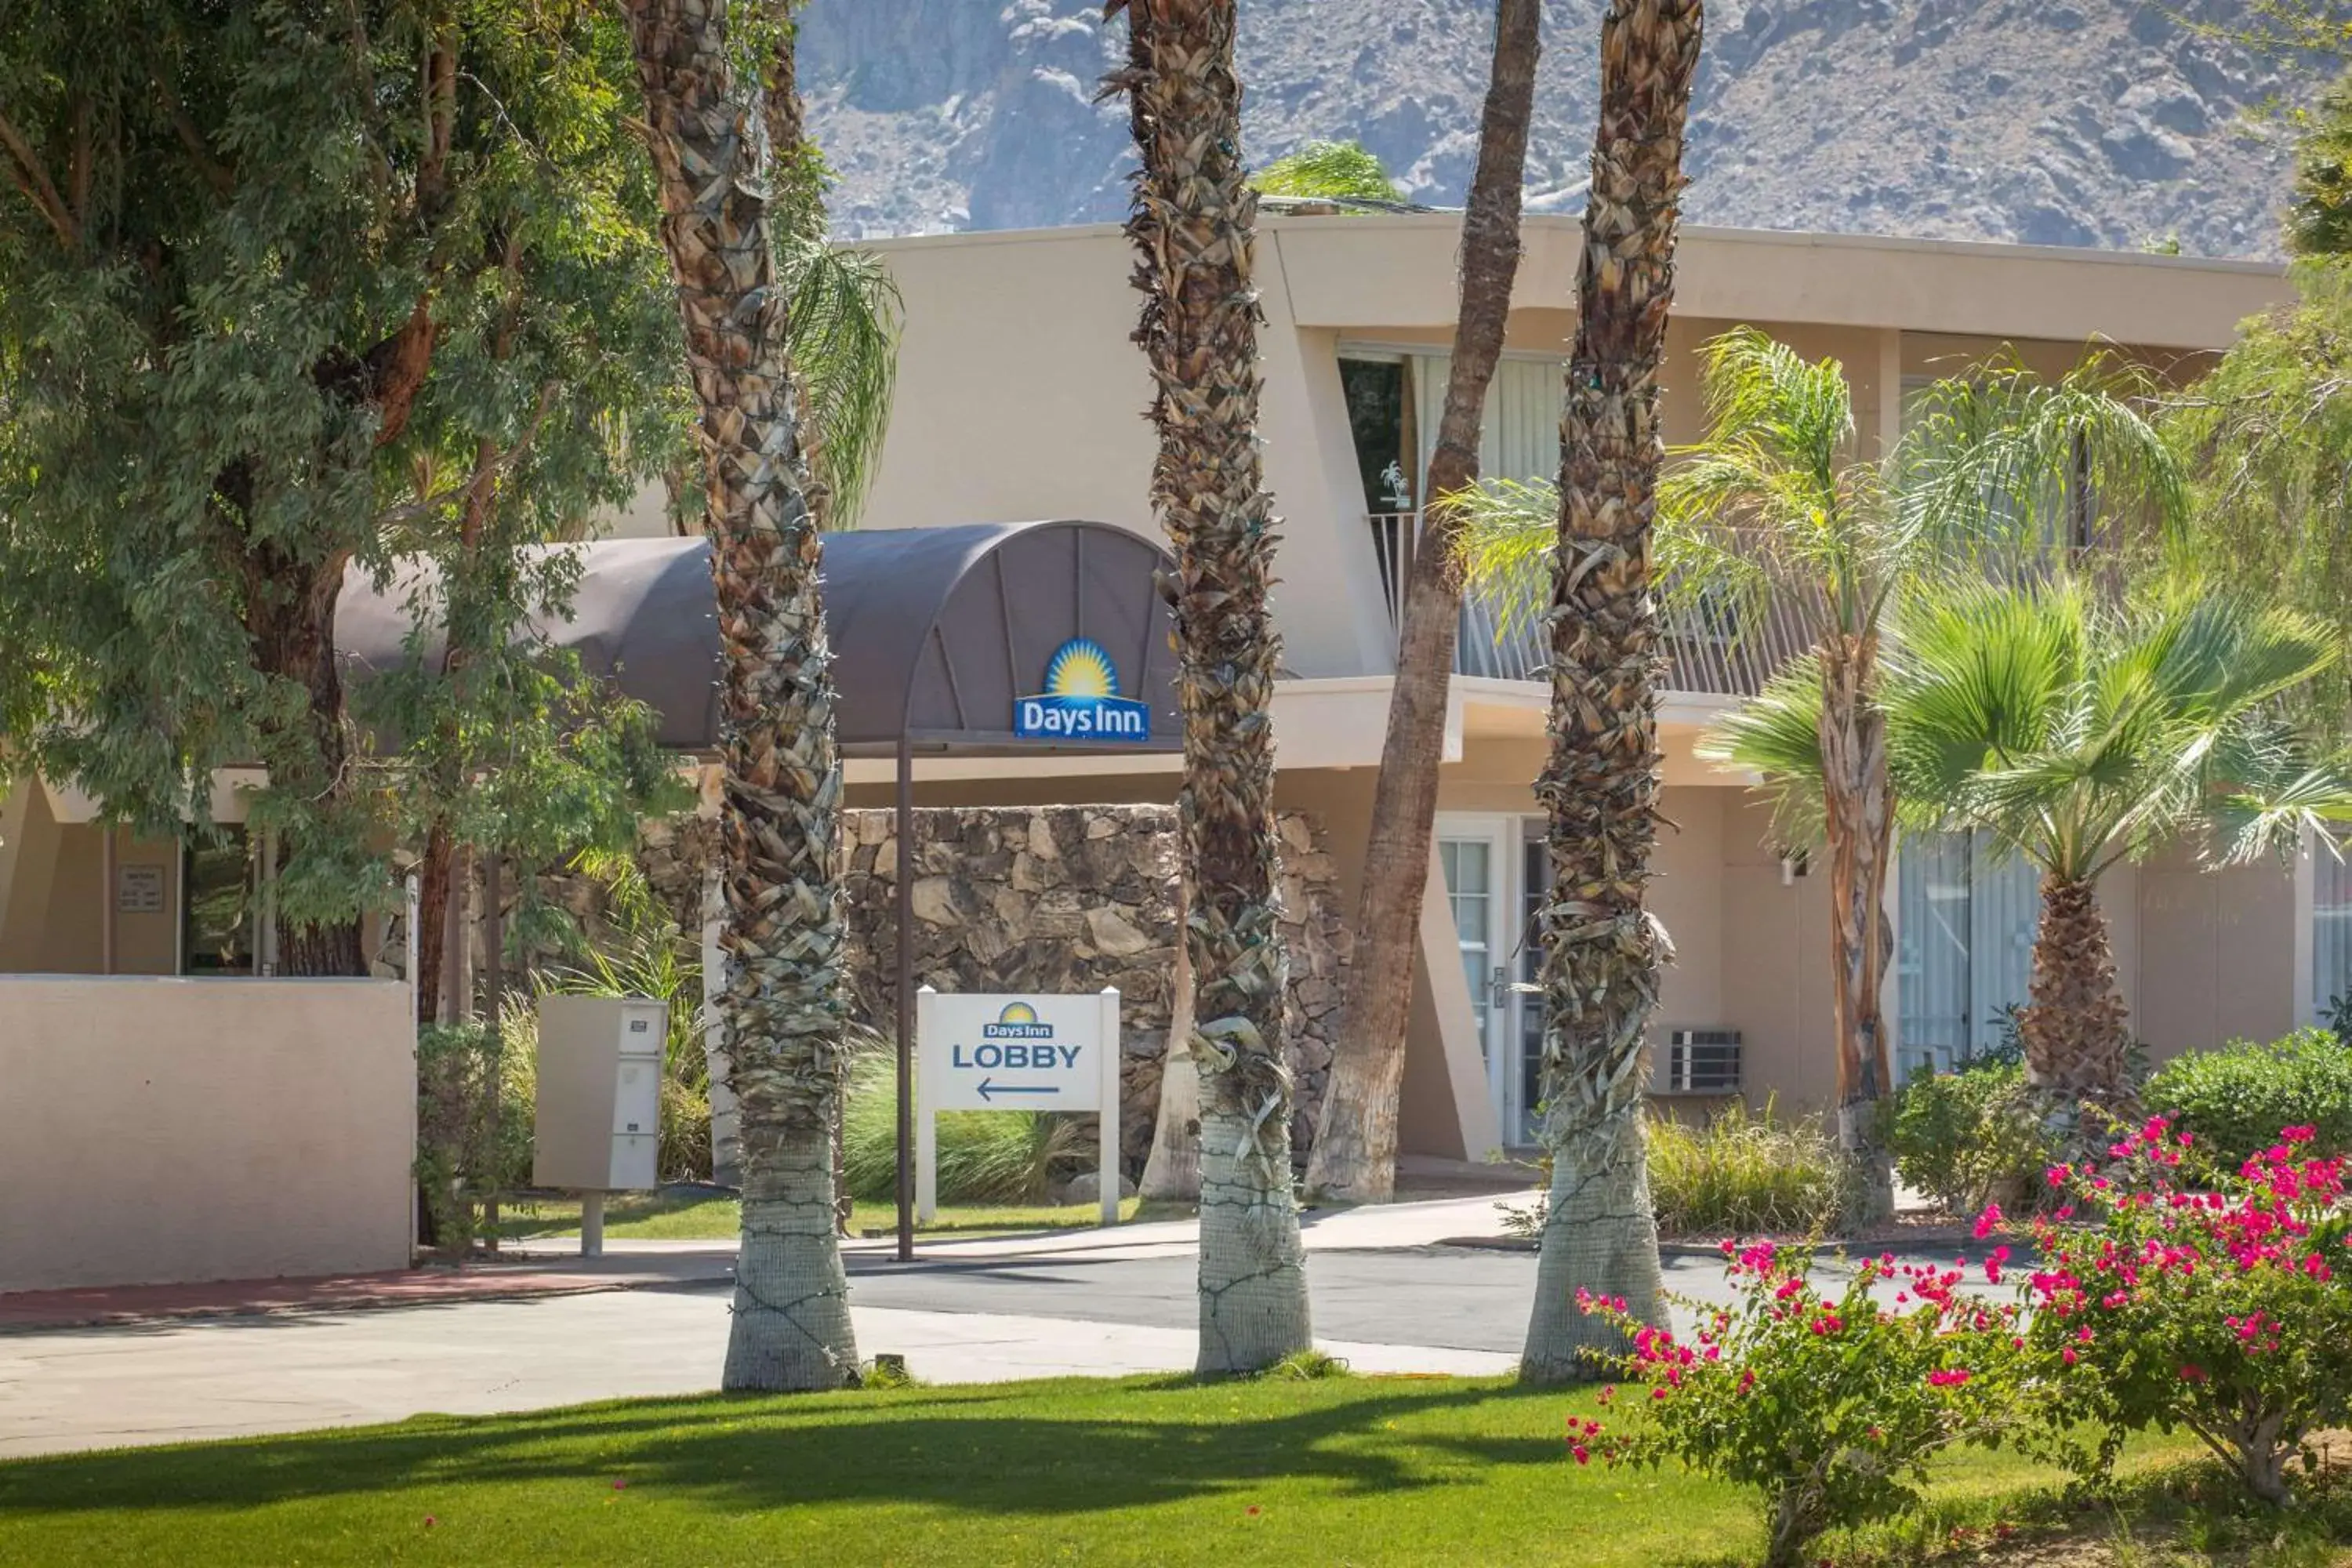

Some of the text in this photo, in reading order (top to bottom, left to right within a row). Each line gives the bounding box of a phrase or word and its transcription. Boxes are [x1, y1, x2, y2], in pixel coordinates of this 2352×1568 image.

[1024, 702, 1141, 735] Days Inn
[987, 1025, 1051, 1037] Days Inn
[953, 1044, 1081, 1069] LOBBY
